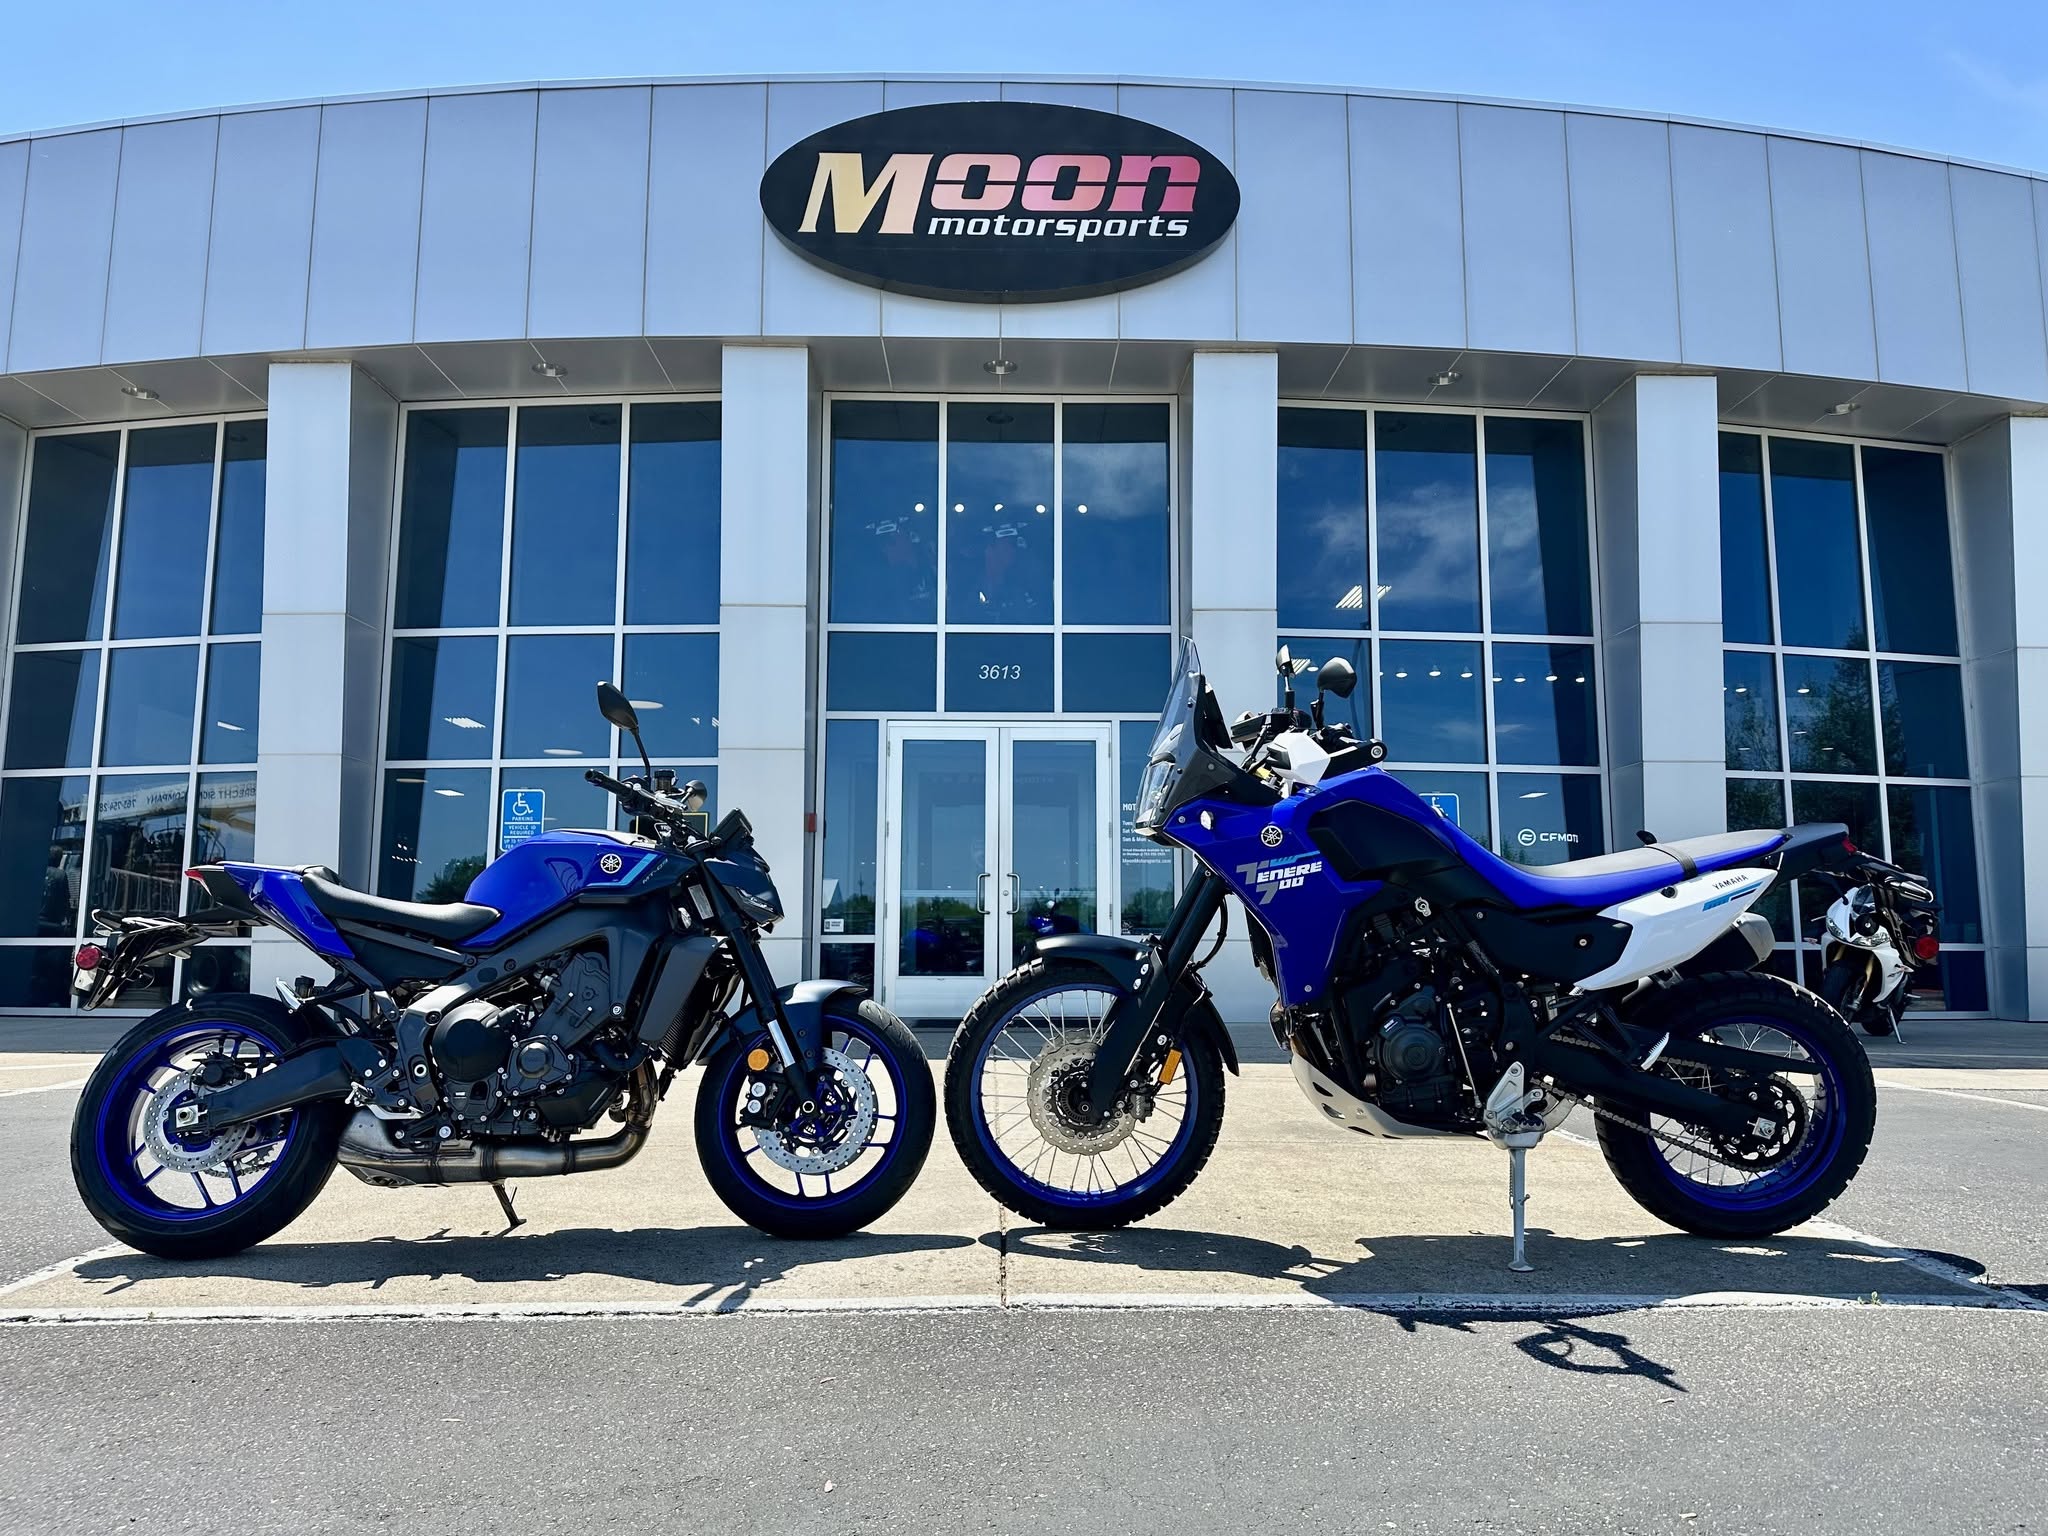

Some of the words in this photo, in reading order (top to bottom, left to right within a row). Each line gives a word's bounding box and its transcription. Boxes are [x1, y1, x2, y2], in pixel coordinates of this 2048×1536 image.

[928, 215, 1189, 242] motorsports
[978, 664, 1021, 680] 3613
[1256, 876, 1304, 905] 700
[1712, 874, 1749, 890] YAMAHA
